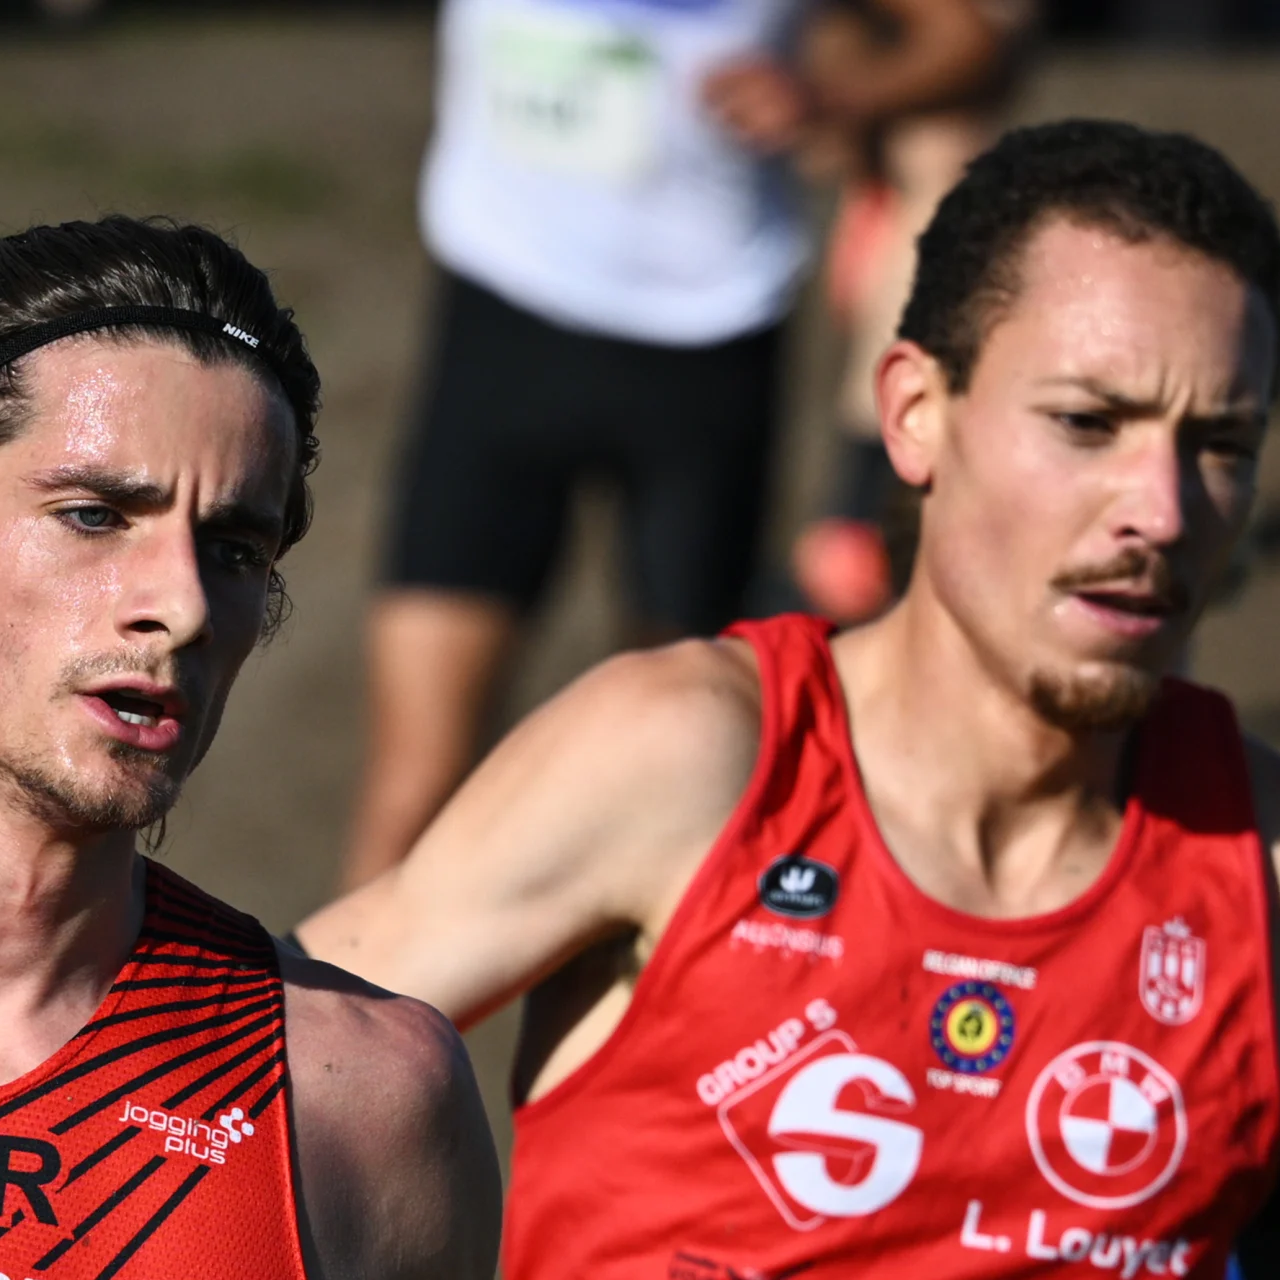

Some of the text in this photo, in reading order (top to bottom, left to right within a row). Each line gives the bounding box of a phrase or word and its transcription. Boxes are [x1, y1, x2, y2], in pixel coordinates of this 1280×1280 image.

[222, 323, 260, 349] NIKE
[696, 998, 838, 1107] GROUP S
[119, 1100, 230, 1150] jogging
[164, 1135, 227, 1165] plus
[960, 1198, 1013, 1254] L.
